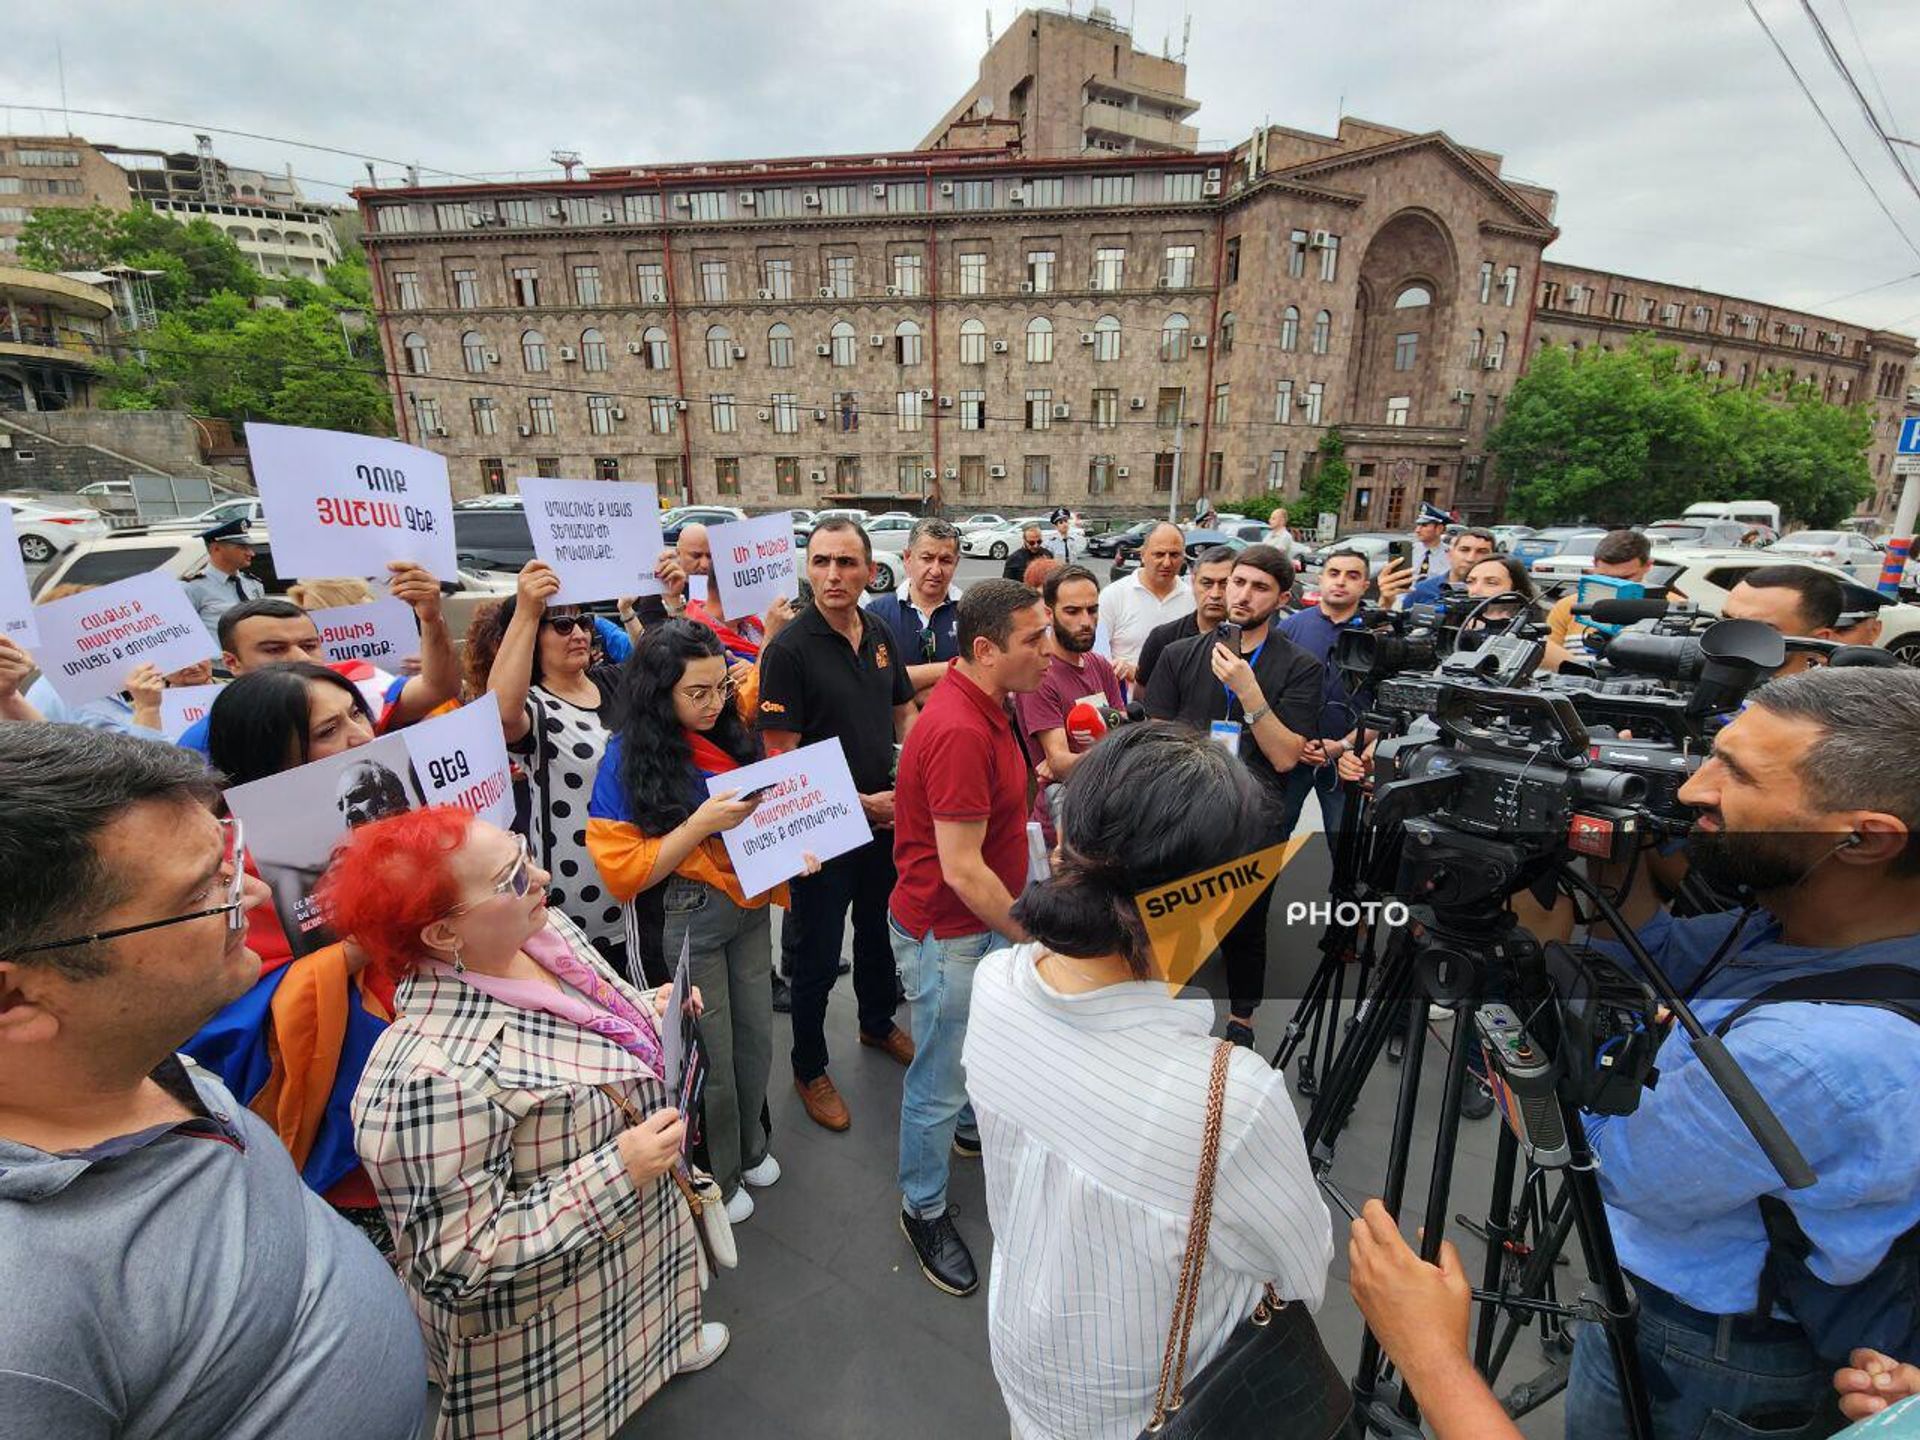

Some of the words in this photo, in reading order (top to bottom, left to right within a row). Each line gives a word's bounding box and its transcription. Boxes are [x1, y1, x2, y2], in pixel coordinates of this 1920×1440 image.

[356, 464, 408, 493] ԴՈՒՔ
[316, 497, 402, 528] ՅԱՇՄԱ
[733, 566, 765, 588] ՄԱՅՐ
[318, 622, 375, 643] ՑԱԿԻՑ
